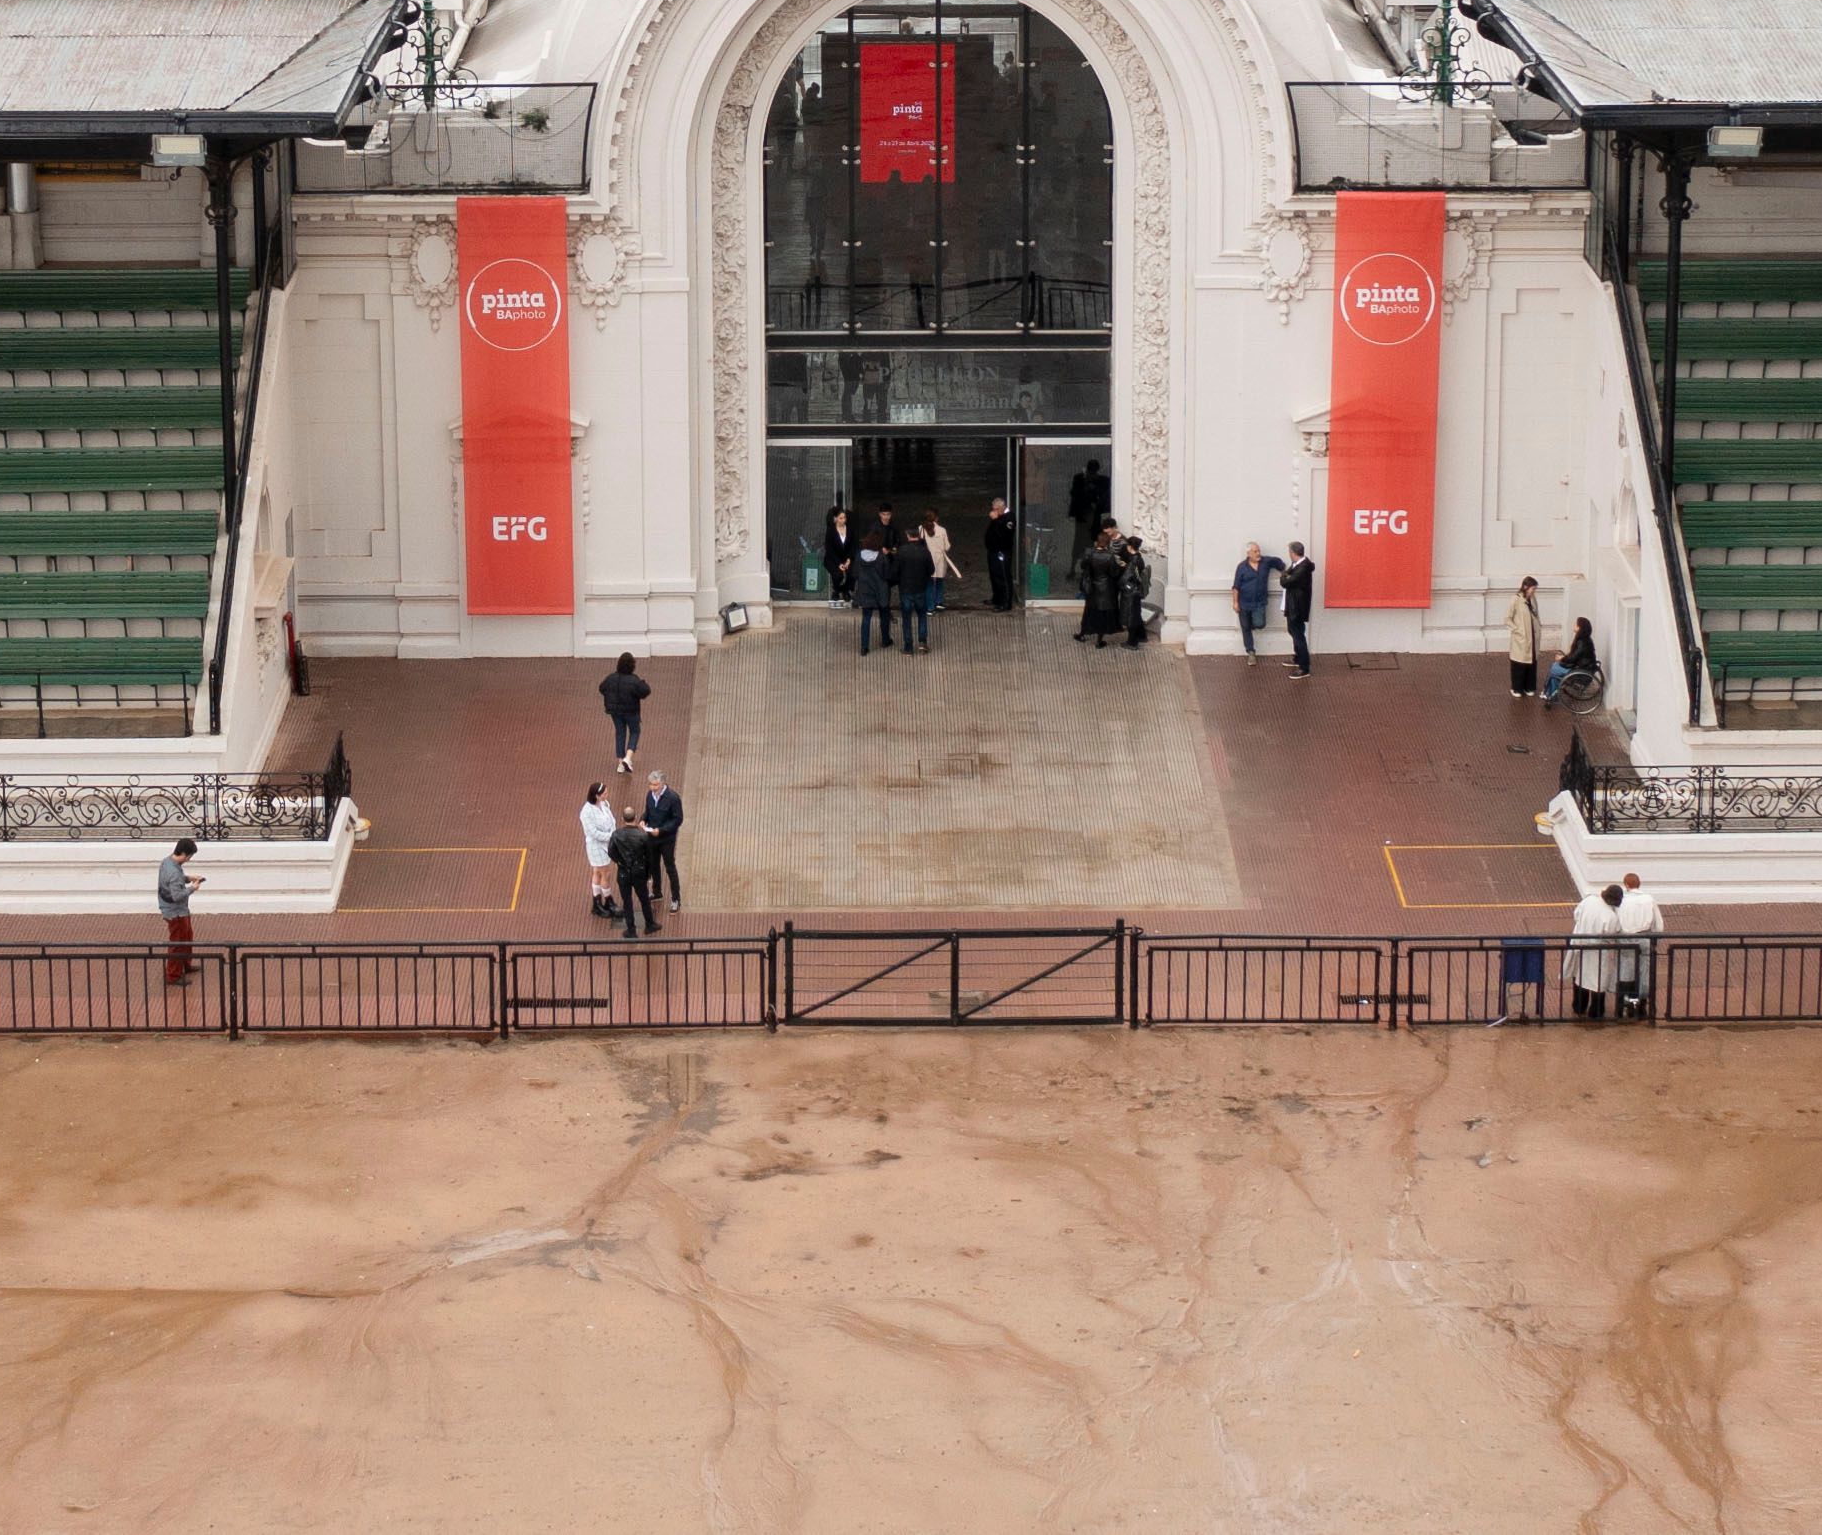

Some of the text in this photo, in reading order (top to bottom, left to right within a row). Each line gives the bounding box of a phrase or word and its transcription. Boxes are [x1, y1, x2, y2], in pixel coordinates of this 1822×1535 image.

[892, 103, 923, 116] pinta
[481, 288, 546, 314] pinta
[1355, 282, 1420, 308] pinta
[496, 309, 546, 321] BAphoto
[1370, 304, 1419, 316] BAphoto
[492, 516, 548, 541] EFG
[1354, 509, 1409, 535] EFG
